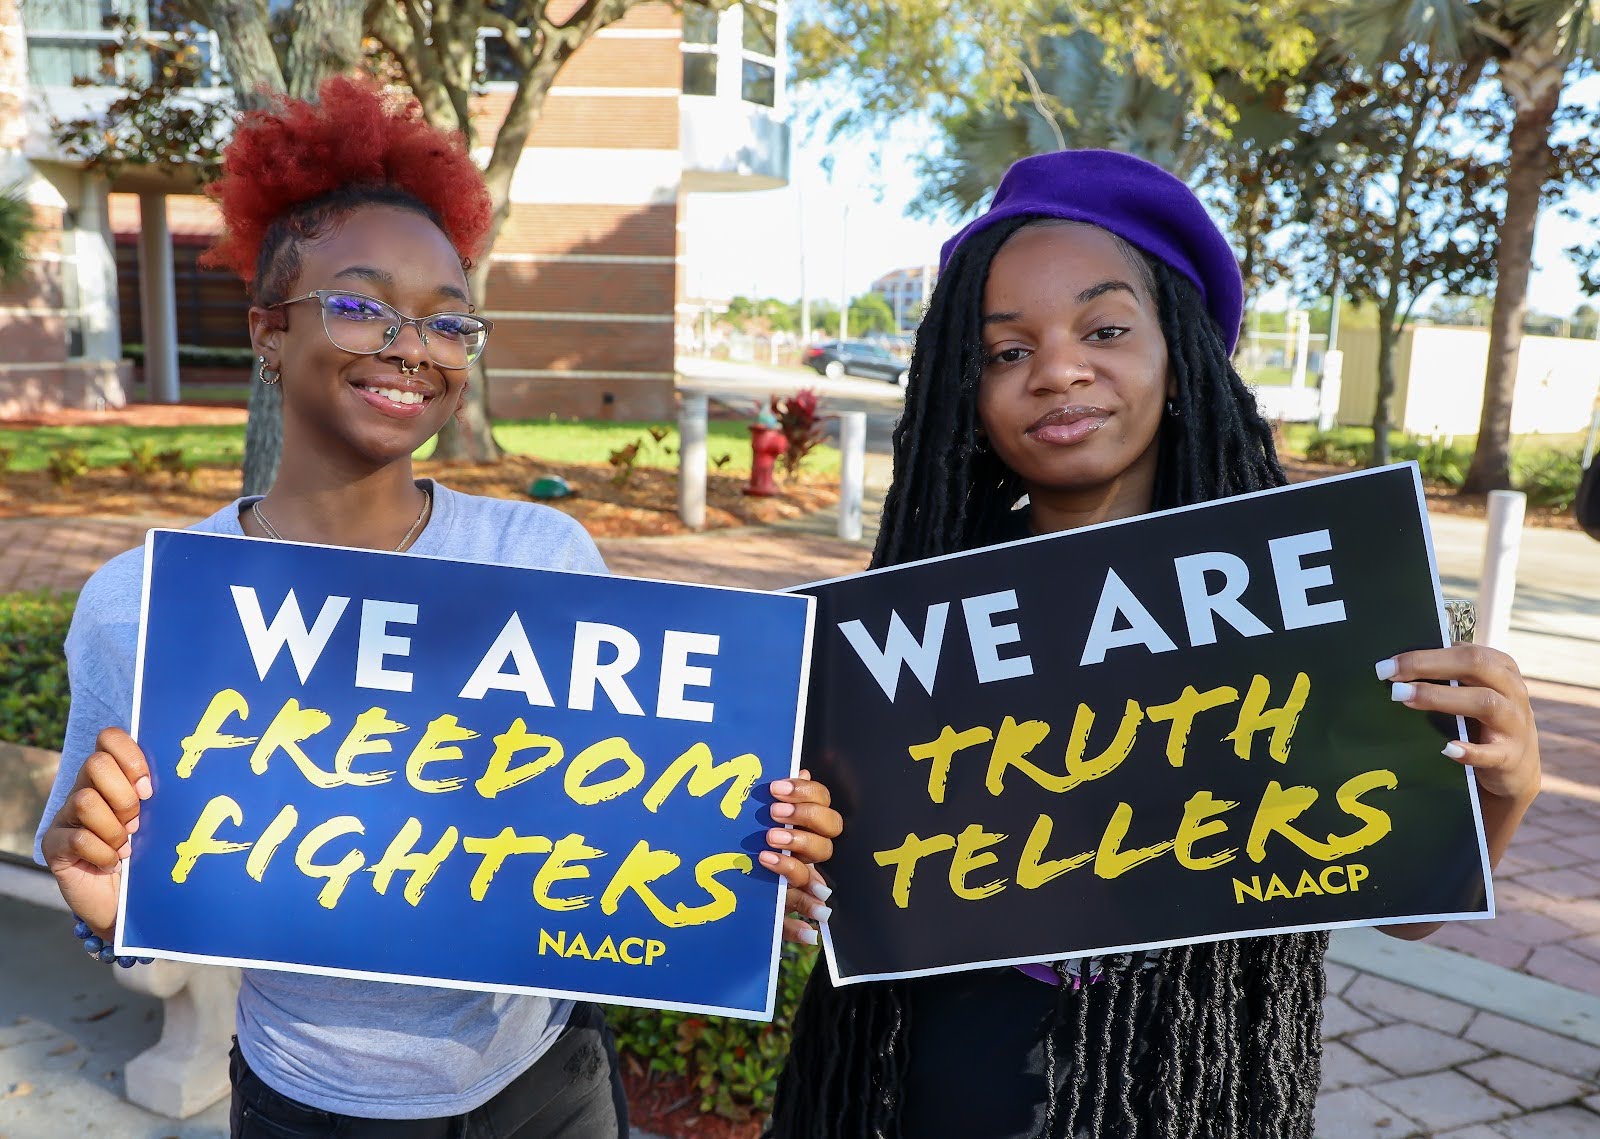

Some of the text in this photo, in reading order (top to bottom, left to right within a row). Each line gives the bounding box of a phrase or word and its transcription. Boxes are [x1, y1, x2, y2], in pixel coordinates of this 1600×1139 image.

[230, 585, 721, 723] WE ARE
[837, 528, 1347, 704] WE ARE
[177, 688, 762, 819] FREEDOM
[908, 672, 1311, 804] TRUTH
[171, 795, 753, 928] FIGHTERS
[873, 769, 1399, 909] TELLERS
[1232, 863, 1370, 904] NAACP
[538, 927, 667, 966] NAACP
